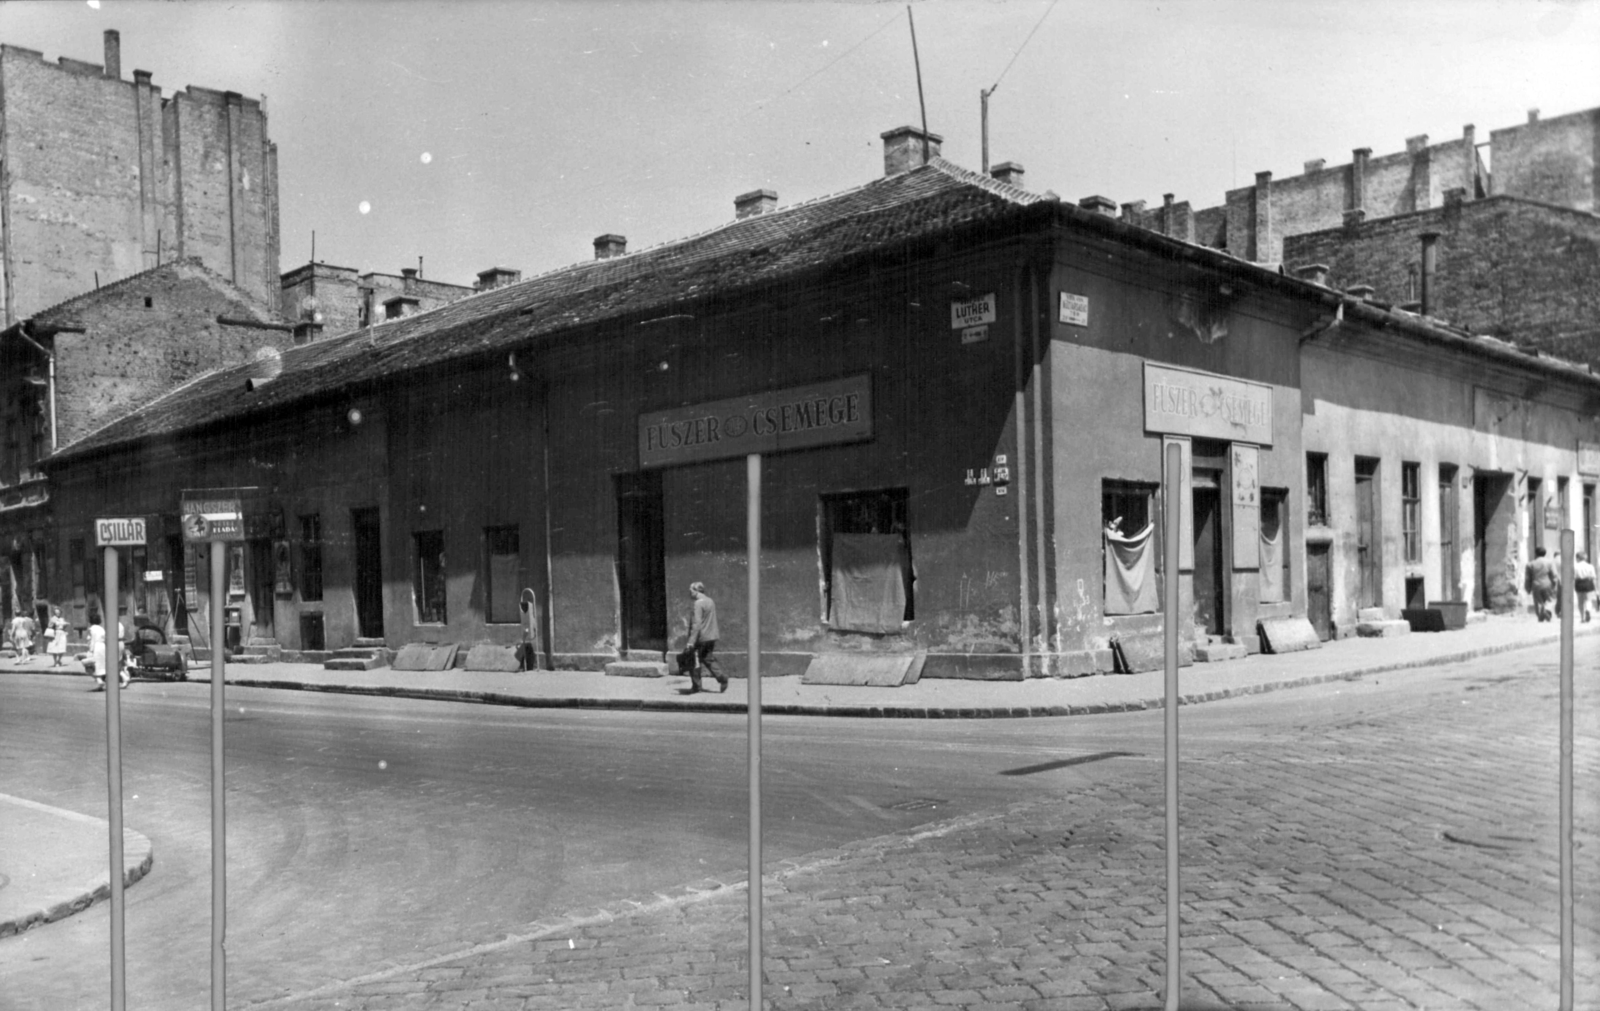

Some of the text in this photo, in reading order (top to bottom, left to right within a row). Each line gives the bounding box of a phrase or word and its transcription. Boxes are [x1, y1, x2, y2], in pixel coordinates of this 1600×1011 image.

[956, 302, 990, 319] LUTHER
[964, 315, 983, 324] UTCA
[752, 393, 860, 436] CSEMEGE
[183, 501, 236, 514] HANGSZER
[100, 519, 144, 542] CSILLÁR
